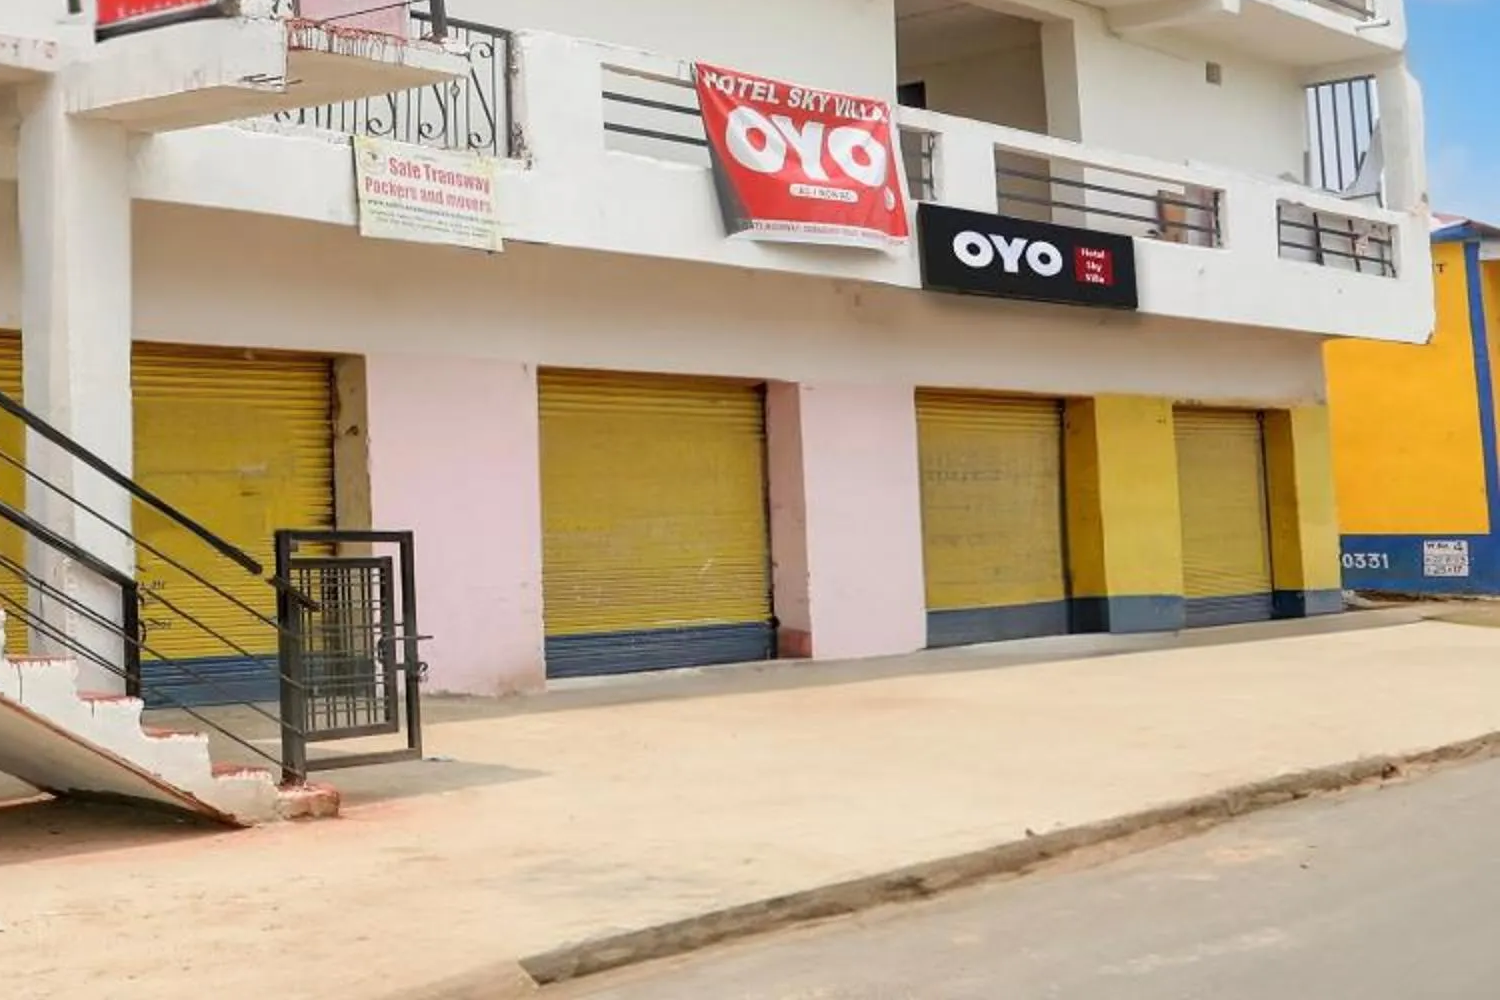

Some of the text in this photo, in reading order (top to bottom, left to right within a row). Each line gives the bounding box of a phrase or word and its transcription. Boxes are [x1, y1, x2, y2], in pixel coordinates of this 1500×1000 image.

[704, 71, 780, 104] HOTEL
[787, 86, 831, 113] SKY
[726, 105, 888, 187] OYO
[420, 188, 444, 205] and
[953, 230, 1063, 277] OYO
[1081, 247, 1105, 259] Hotel
[1085, 260, 1104, 273] Sky
[1342, 553, 1389, 569] 0331
